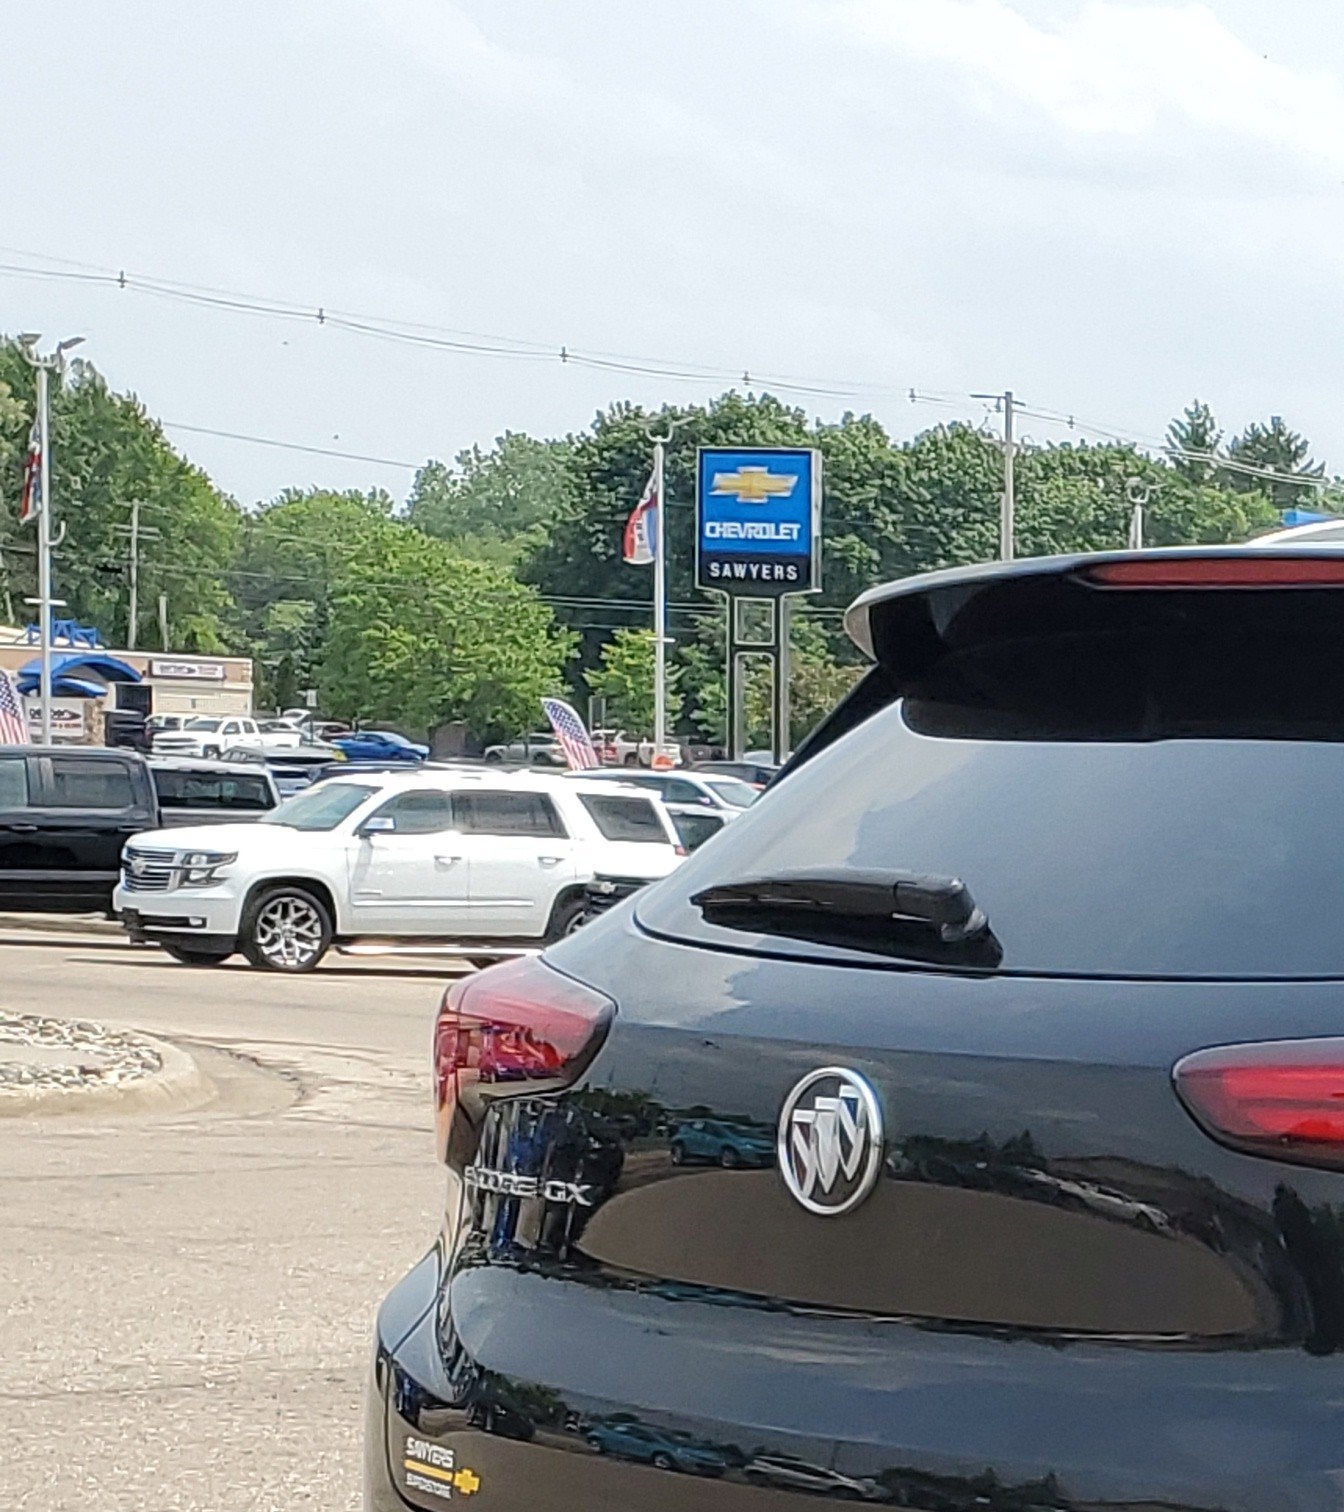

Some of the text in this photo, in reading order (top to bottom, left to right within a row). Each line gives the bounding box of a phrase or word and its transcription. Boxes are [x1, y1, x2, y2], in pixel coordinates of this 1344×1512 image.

[704, 521, 801, 540] CHEVROLET
[709, 562, 798, 580] SAWYERS
[543, 1179, 593, 1206] GX
